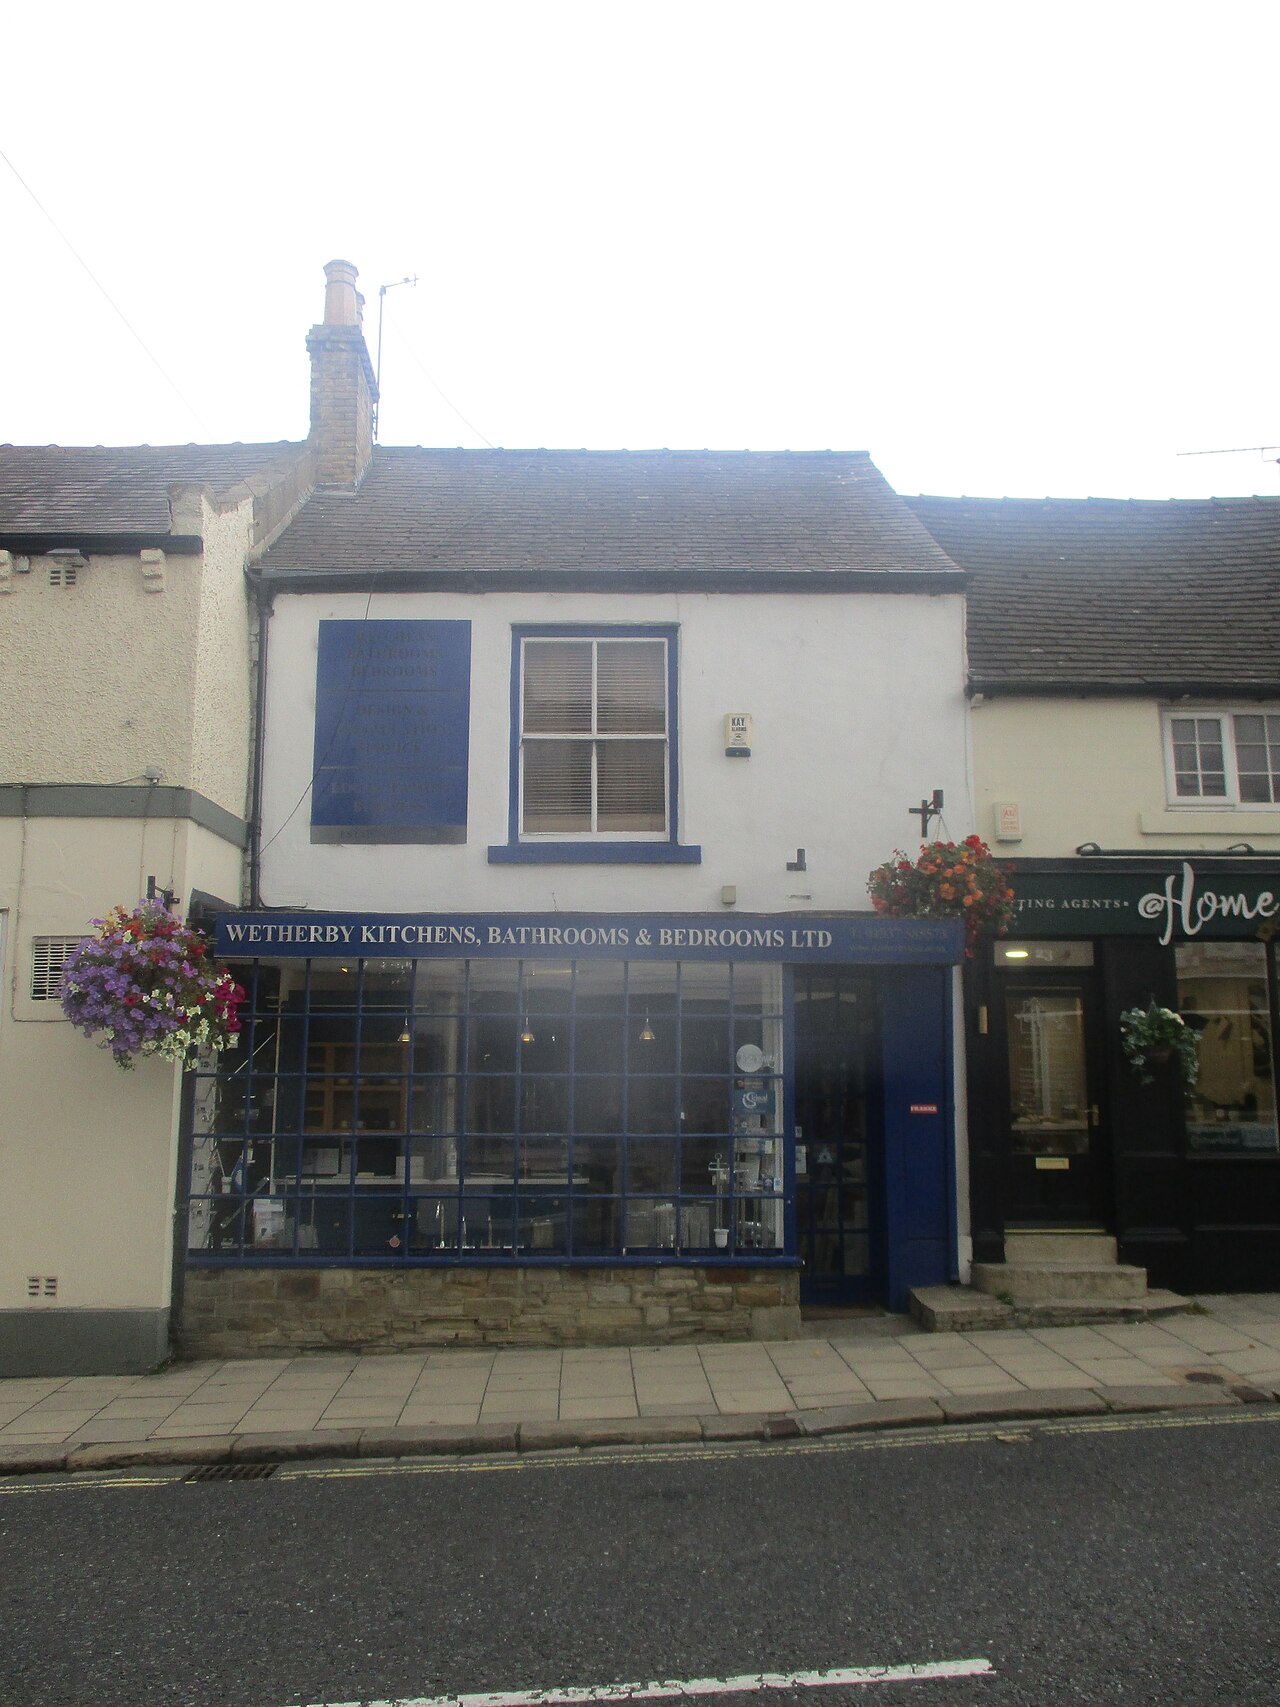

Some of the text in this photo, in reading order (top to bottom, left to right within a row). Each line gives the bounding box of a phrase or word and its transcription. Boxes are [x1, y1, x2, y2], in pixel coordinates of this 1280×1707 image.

[731, 717, 745, 726] KAY
[1017, 897, 1121, 910] TING AGENTS
[1138, 862, 1279, 946] @Home
[225, 924, 356, 944] WETHERBY
[361, 925, 481, 948] KITCHENS,
[487, 925, 629, 946] BATHROOMS
[634, 927, 653, 946] &
[658, 928, 785, 947] BEDROOMS
[791, 929, 833, 949] LTD
